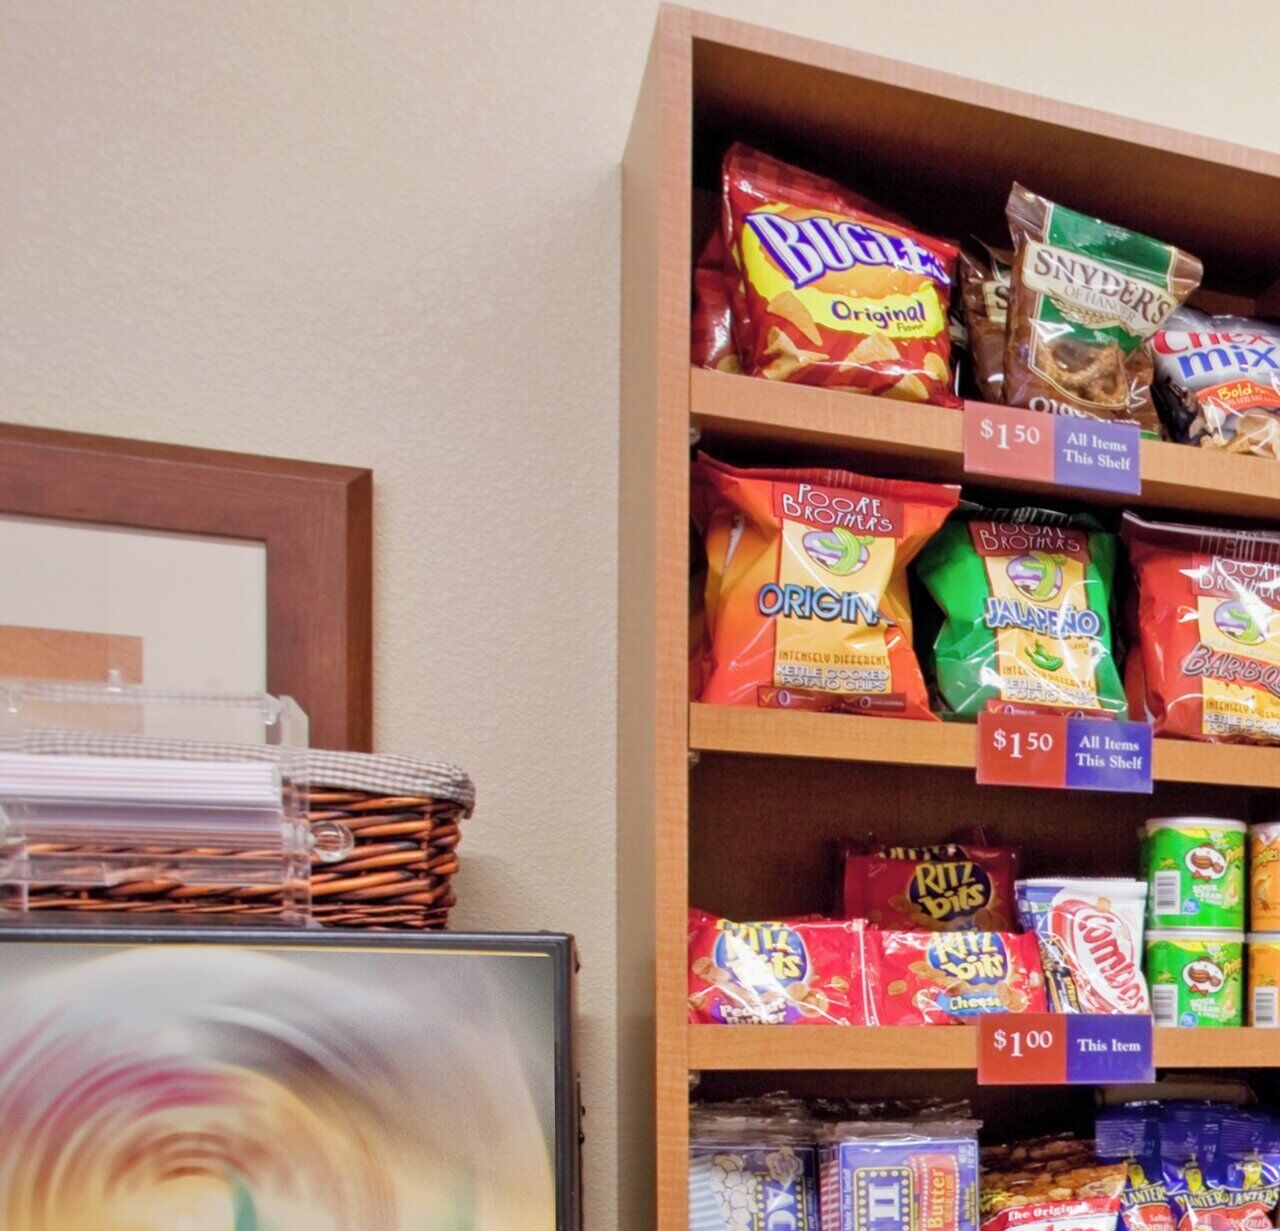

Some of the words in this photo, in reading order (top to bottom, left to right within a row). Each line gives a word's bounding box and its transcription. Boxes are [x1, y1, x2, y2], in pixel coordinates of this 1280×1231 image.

[1033, 248, 1173, 328] SNYDER'S
[831, 300, 926, 329] Original
[1180, 344, 1280, 379] mix
[1217, 384, 1252, 400] Bold
[1067, 432, 1088, 446] All
[1091, 435, 1128, 452] Items
[1063, 449, 1092, 466] This
[1097, 454, 1132, 471] Shelf
[783, 493, 893, 532] BROTHERS
[798, 482, 882, 517] POORE
[1075, 752, 1105, 768] This
[1109, 754, 1143, 770] Shelf
[1079, 736, 1100, 749] All
[1103, 736, 1140, 752] Items
[915, 862, 976, 897] RITZ
[918, 882, 985, 919] bits
[1075, 907, 1146, 1012] Combos
[1077, 1038, 1108, 1052] This
[1112, 1039, 1141, 1052] Item
[869, 1183, 900, 1222] II
[926, 1169, 946, 1229] Butter
